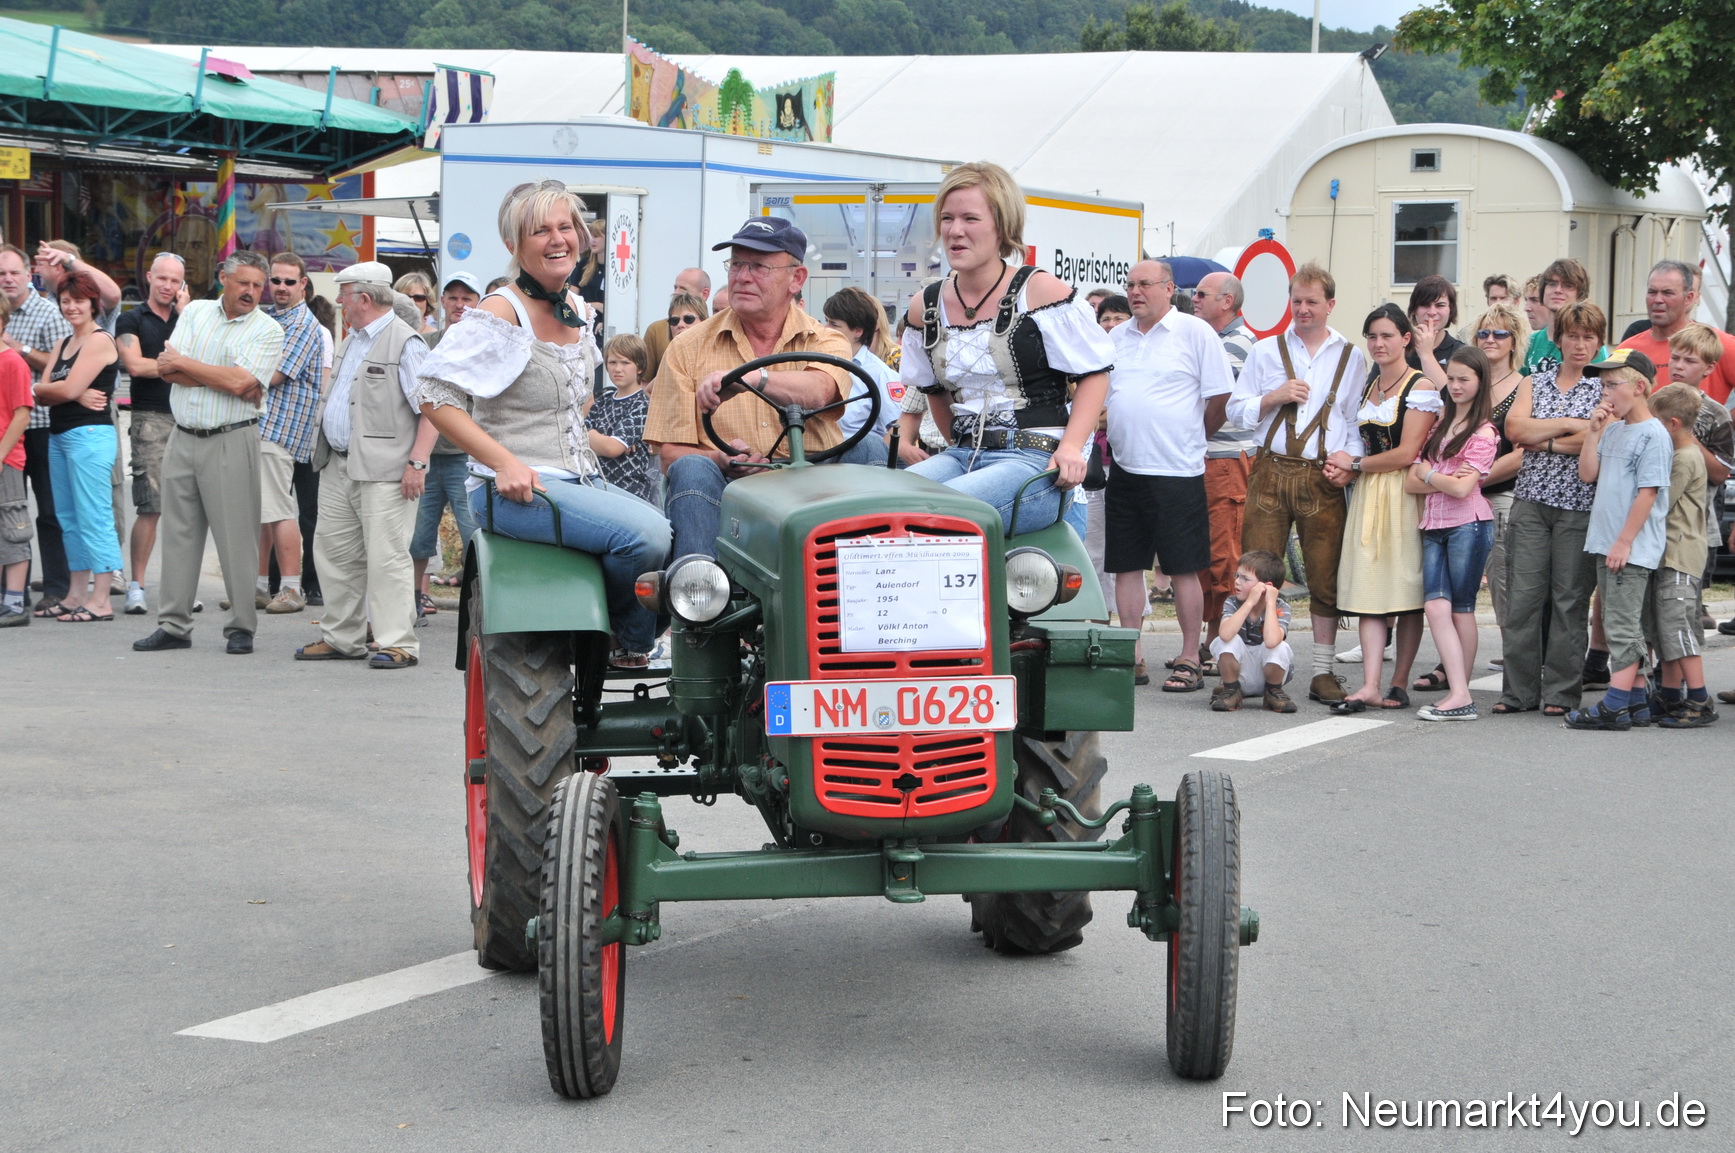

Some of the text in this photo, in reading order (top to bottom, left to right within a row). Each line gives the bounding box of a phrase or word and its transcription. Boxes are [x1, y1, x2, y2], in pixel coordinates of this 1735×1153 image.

[612, 214, 635, 243] DEUTSCHES
[622, 253, 636, 290] KREUZ
[1055, 249, 1129, 287] Bayerisches
[944, 574, 977, 588] 137
[876, 595, 899, 603] 1954
[878, 637, 918, 645] Berching
[775, 714, 785, 727] D
[813, 688, 868, 728] NM
[897, 684, 995, 726] 0628
